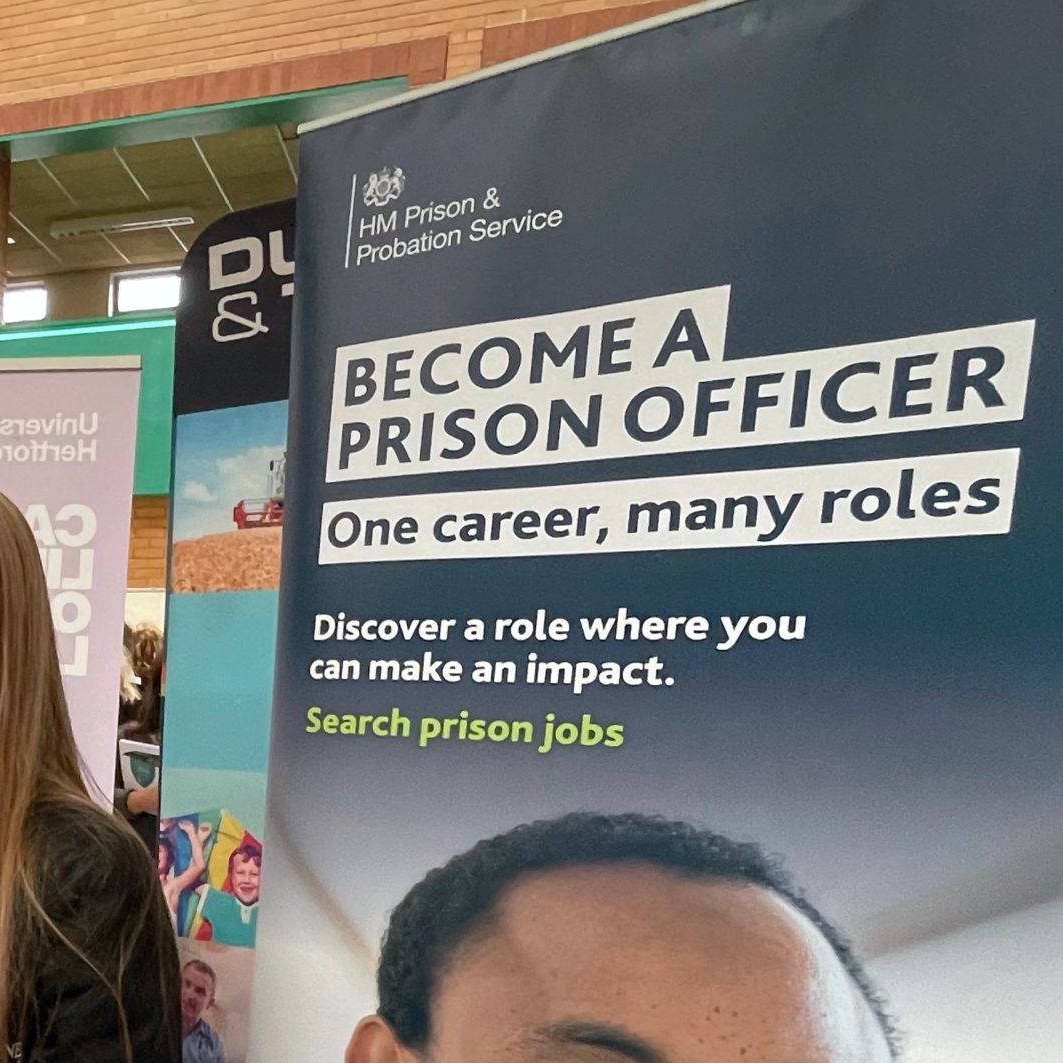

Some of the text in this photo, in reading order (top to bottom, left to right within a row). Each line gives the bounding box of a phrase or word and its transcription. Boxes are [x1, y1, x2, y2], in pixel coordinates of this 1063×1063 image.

[356, 209, 562, 265] Probation Service
[359, 187, 500, 238] HM Prison &
[344, 308, 710, 406] BECOME A
[338, 346, 1005, 470] PRISON OFFICER
[327, 467, 1000, 548] One career, many roles
[313, 607, 806, 650] Discover a role where you
[309, 651, 674, 693] can make an impact.
[305, 706, 623, 753] Search prison jobs
